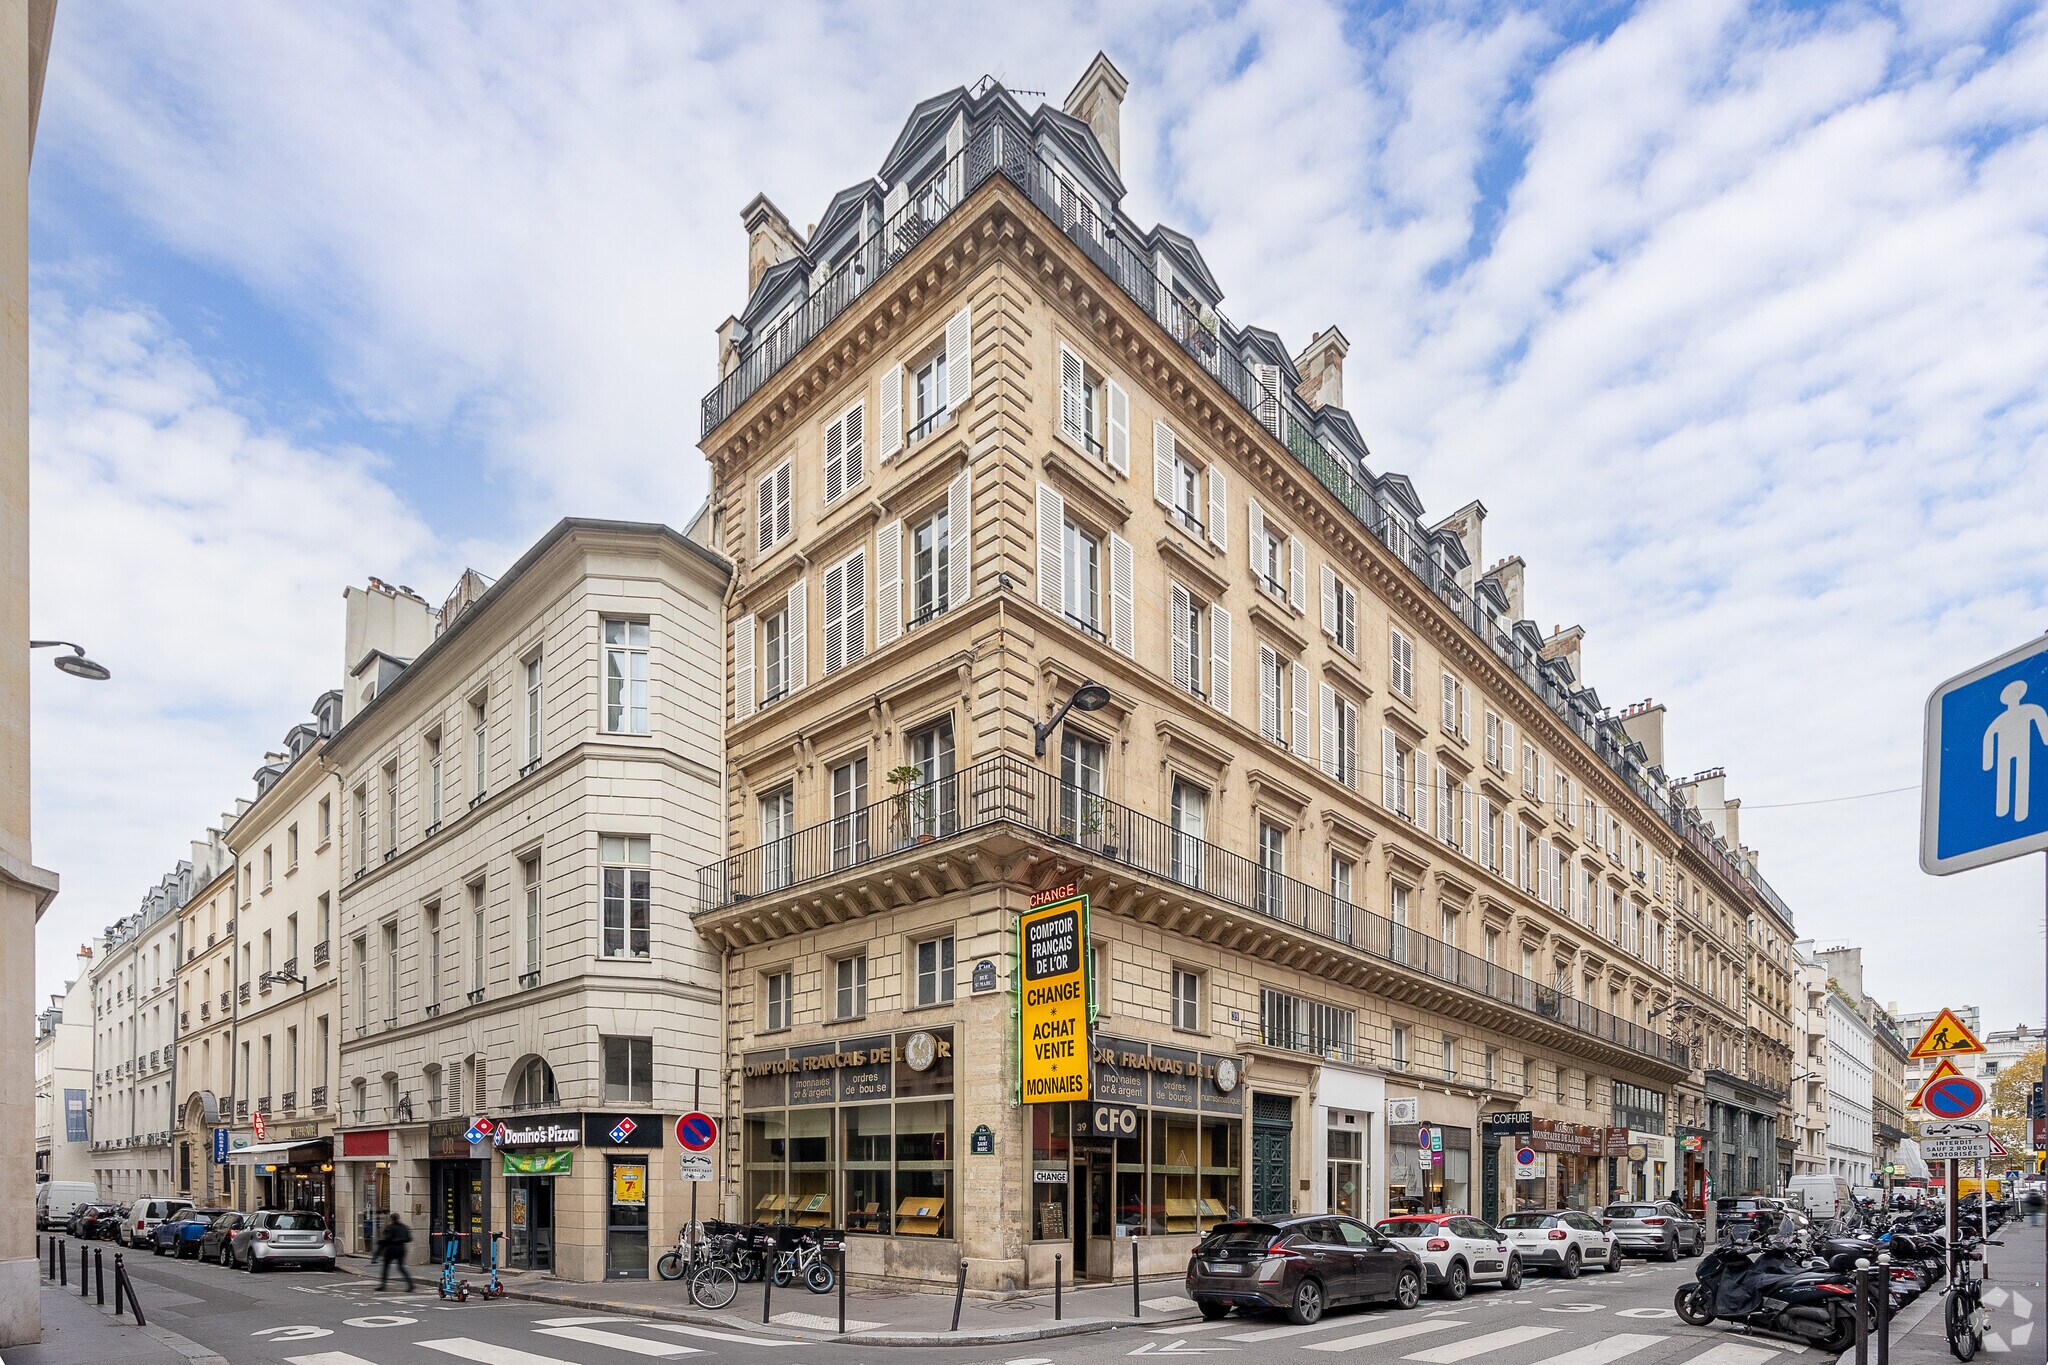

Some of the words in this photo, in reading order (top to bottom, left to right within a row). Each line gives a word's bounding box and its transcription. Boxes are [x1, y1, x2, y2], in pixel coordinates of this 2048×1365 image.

[1029, 883, 1075, 907] CHANGE
[1030, 917, 1074, 941] COMPTOIR
[1031, 935, 1073, 958] FRANÇAIS
[1036, 959, 1048, 975] DE
[1050, 954, 1068, 972] L'OR
[1027, 981, 1080, 1006] CHANGE
[1033, 1018, 1076, 1040] ACHAT
[1035, 1040, 1075, 1061] VENTE
[742, 1058, 801, 1078] COMPTOIR
[870, 1047, 892, 1064] DE
[1186, 1061, 1203, 1078] DE
[852, 1073, 879, 1083] ordres
[1027, 1074, 1083, 1096] MONNAIES
[793, 1090, 801, 1099] or
[808, 1087, 832, 1099] argent
[845, 1085, 855, 1095] de
[1101, 1085, 1110, 1094] or
[1110, 1084, 1117, 1094] &
[1118, 1087, 1143, 1098] argent
[1163, 1081, 1187, 1092] ordres
[1156, 1090, 1166, 1100] de
[1168, 1092, 1193, 1103] bourse
[1201, 1094, 1241, 1106] numismatique
[255, 1112, 264, 1139] TABAC
[1094, 1107, 1137, 1133] CFO
[1493, 1113, 1530, 1125] COIFFURE
[1077, 1122, 1087, 1132] 39
[1554, 1124, 1574, 1134] MAISON
[505, 1125, 546, 1145] Domino's
[547, 1125, 579, 1142] Pizza
[1561, 1134, 1568, 1142] DE
[1568, 1135, 1575, 1143] LA
[1575, 1136, 1591, 1145] BOURSE
[442, 1137, 455, 1154] OR
[1545, 1141, 1581, 1154] NUMISMATIQUE
[1931, 1150, 1978, 1158] MOTORISÉS
[1036, 1171, 1066, 1181] CHANGE
